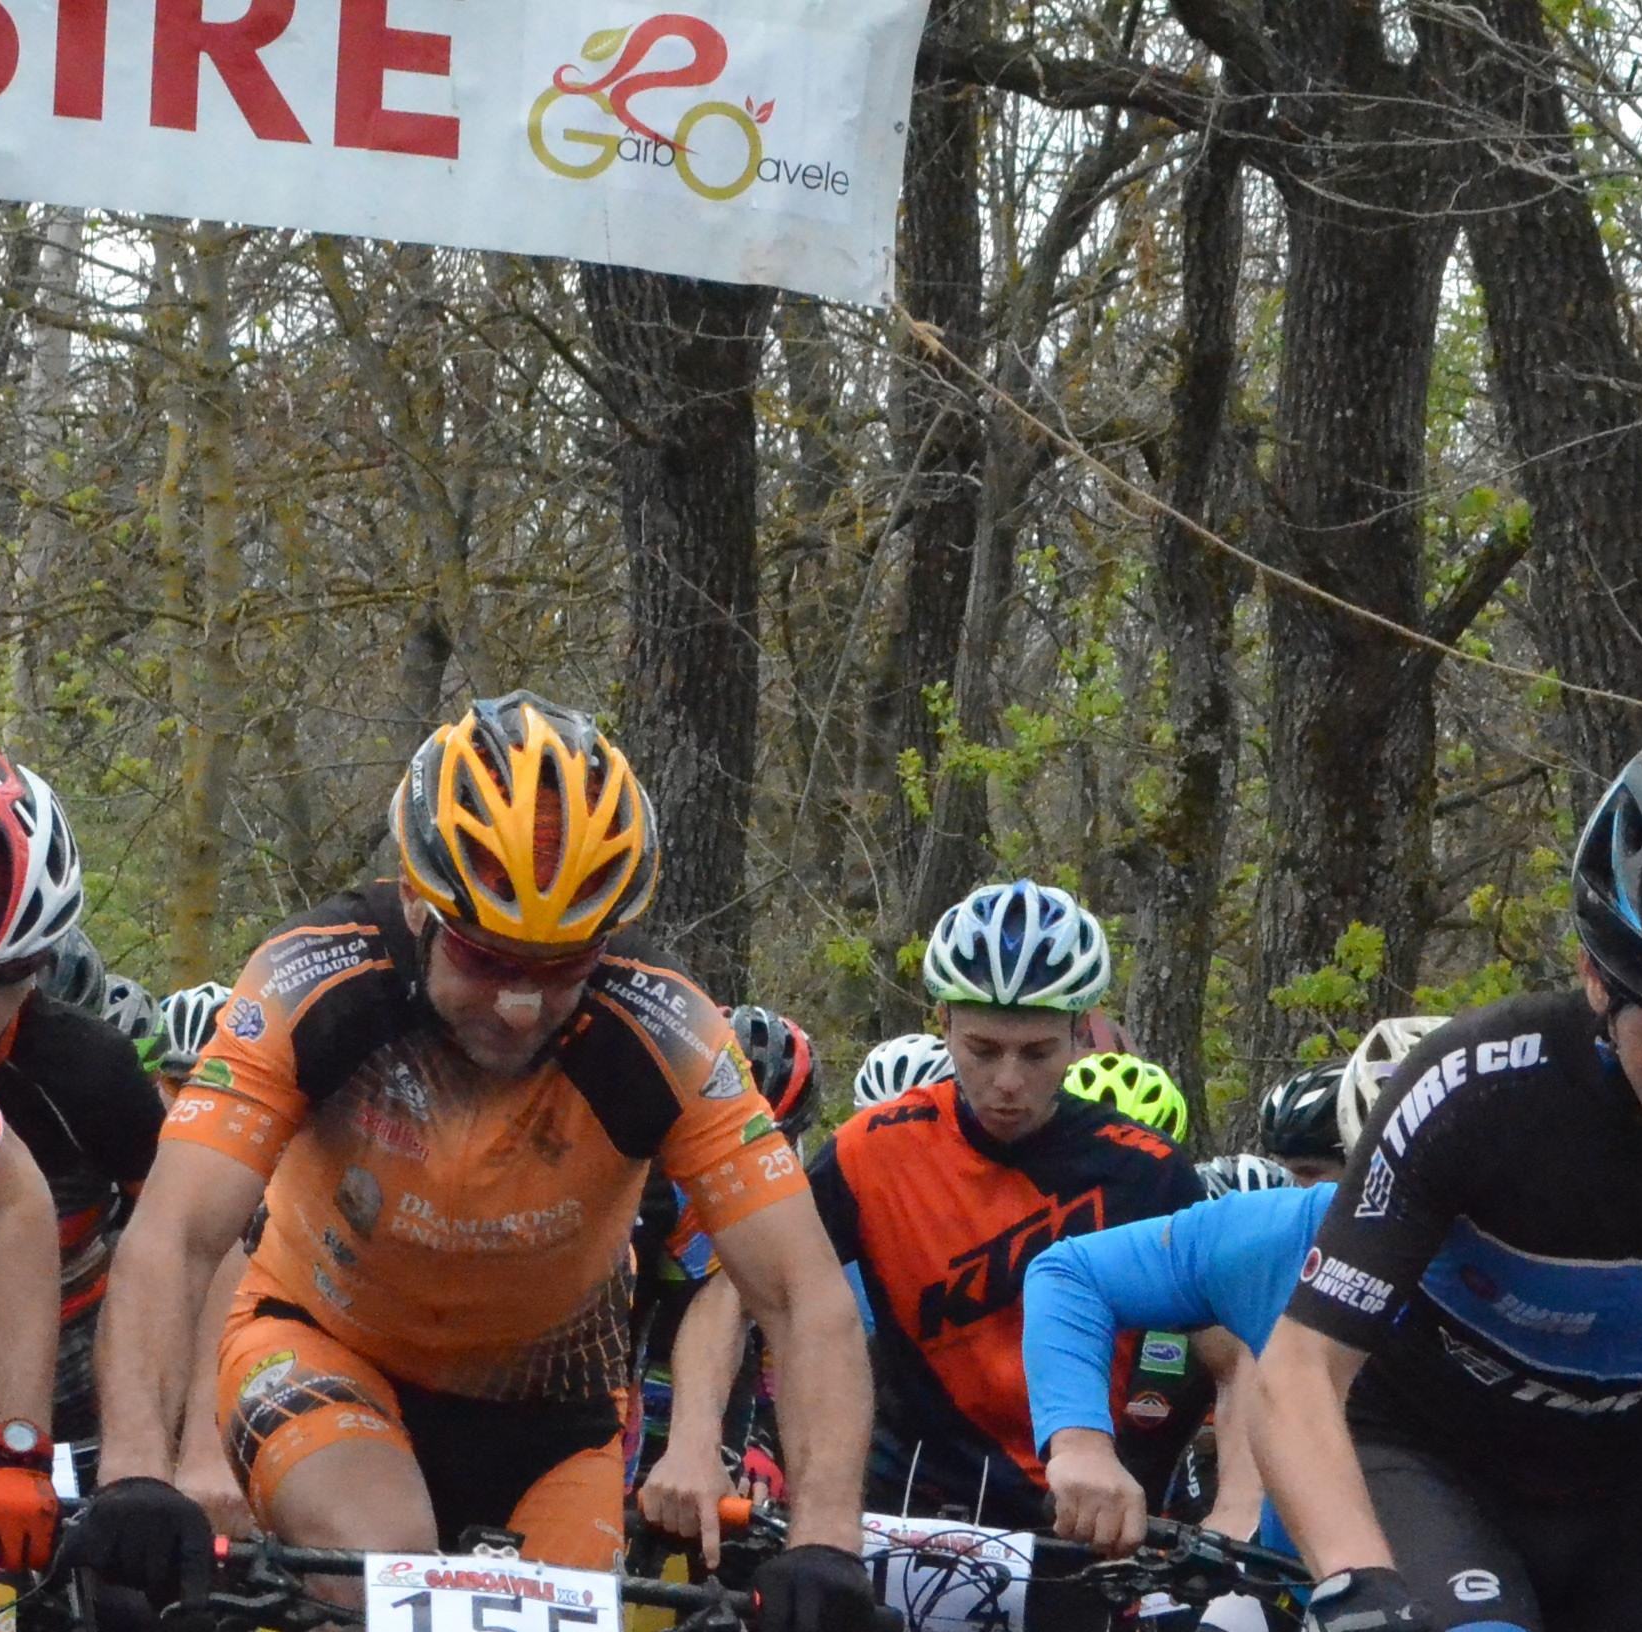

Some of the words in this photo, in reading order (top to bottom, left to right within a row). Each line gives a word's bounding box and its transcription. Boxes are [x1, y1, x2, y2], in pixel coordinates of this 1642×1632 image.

[630, 971, 688, 1019] D.A.E.
[1382, 1047, 1467, 1159] TIRE
[1476, 1032, 1548, 1075] CO.
[1312, 1273, 1386, 1315] ANVELOP
[1321, 1256, 1395, 1300] DIMSIM
